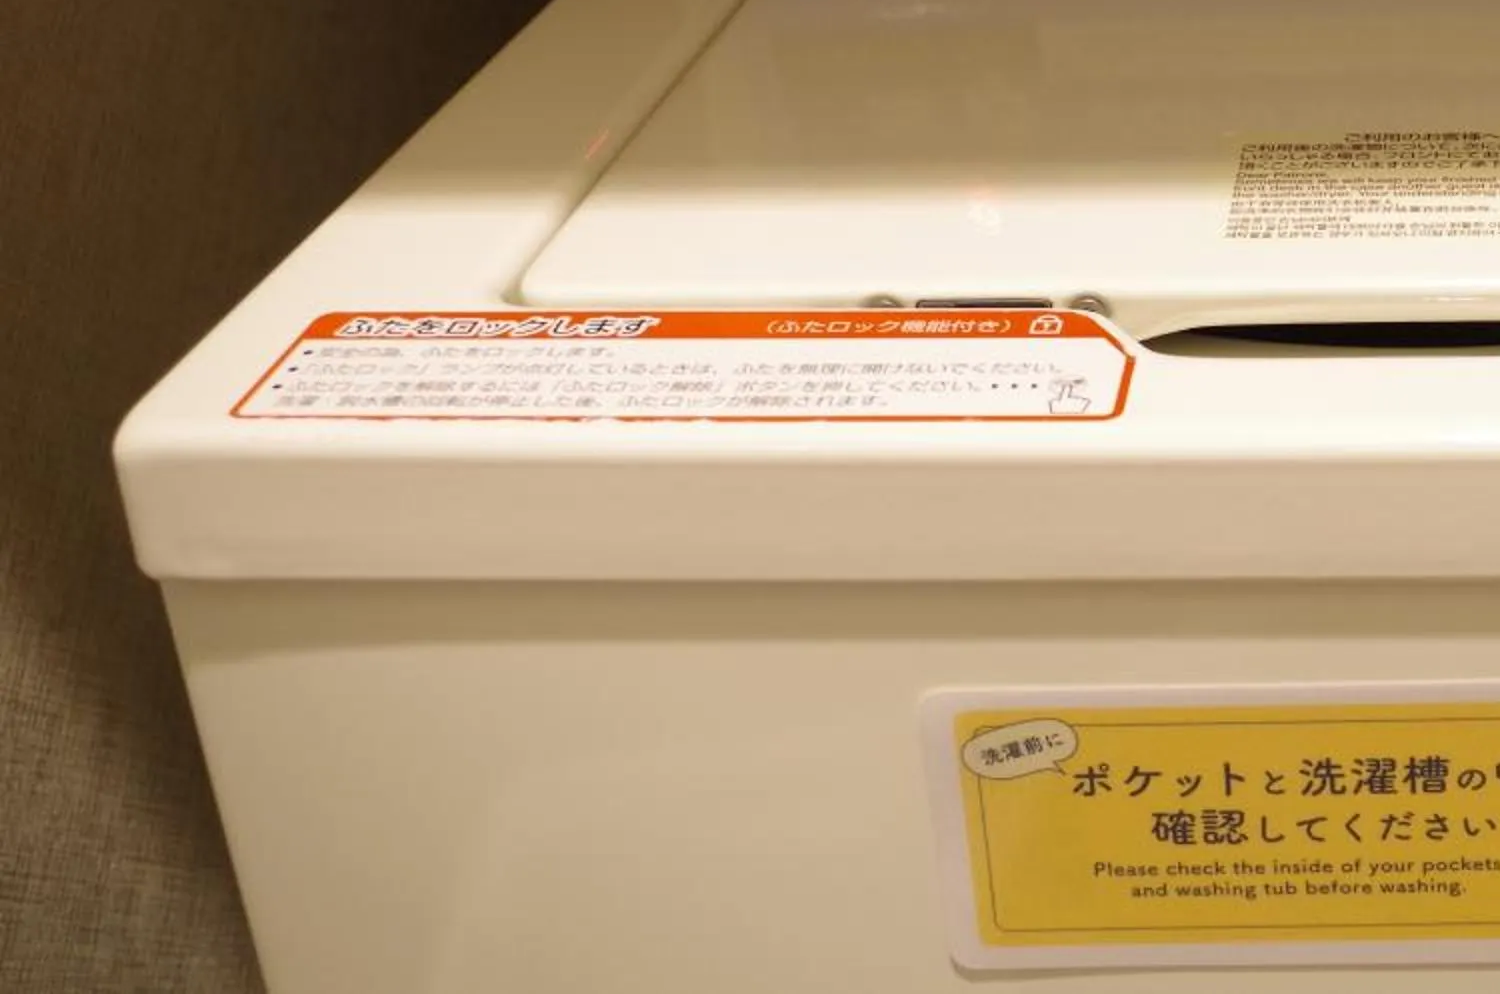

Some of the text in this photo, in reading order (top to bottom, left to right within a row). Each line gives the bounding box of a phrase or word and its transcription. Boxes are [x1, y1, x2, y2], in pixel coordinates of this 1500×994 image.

[334, 317, 1013, 337] ふたをロックします （ふたロック機能付き）
[981, 733, 1065, 766] 洗濯前に
[1151, 808, 1497, 847] 確認してください
[1093, 861, 1160, 877] Please
[1166, 860, 1226, 876] check
[1233, 859, 1266, 875] the
[1272, 859, 1334, 875] inside
[1341, 858, 1362, 874] of
[1368, 861, 1415, 876] your
[1131, 878, 1468, 900] and washing tub before washing.
